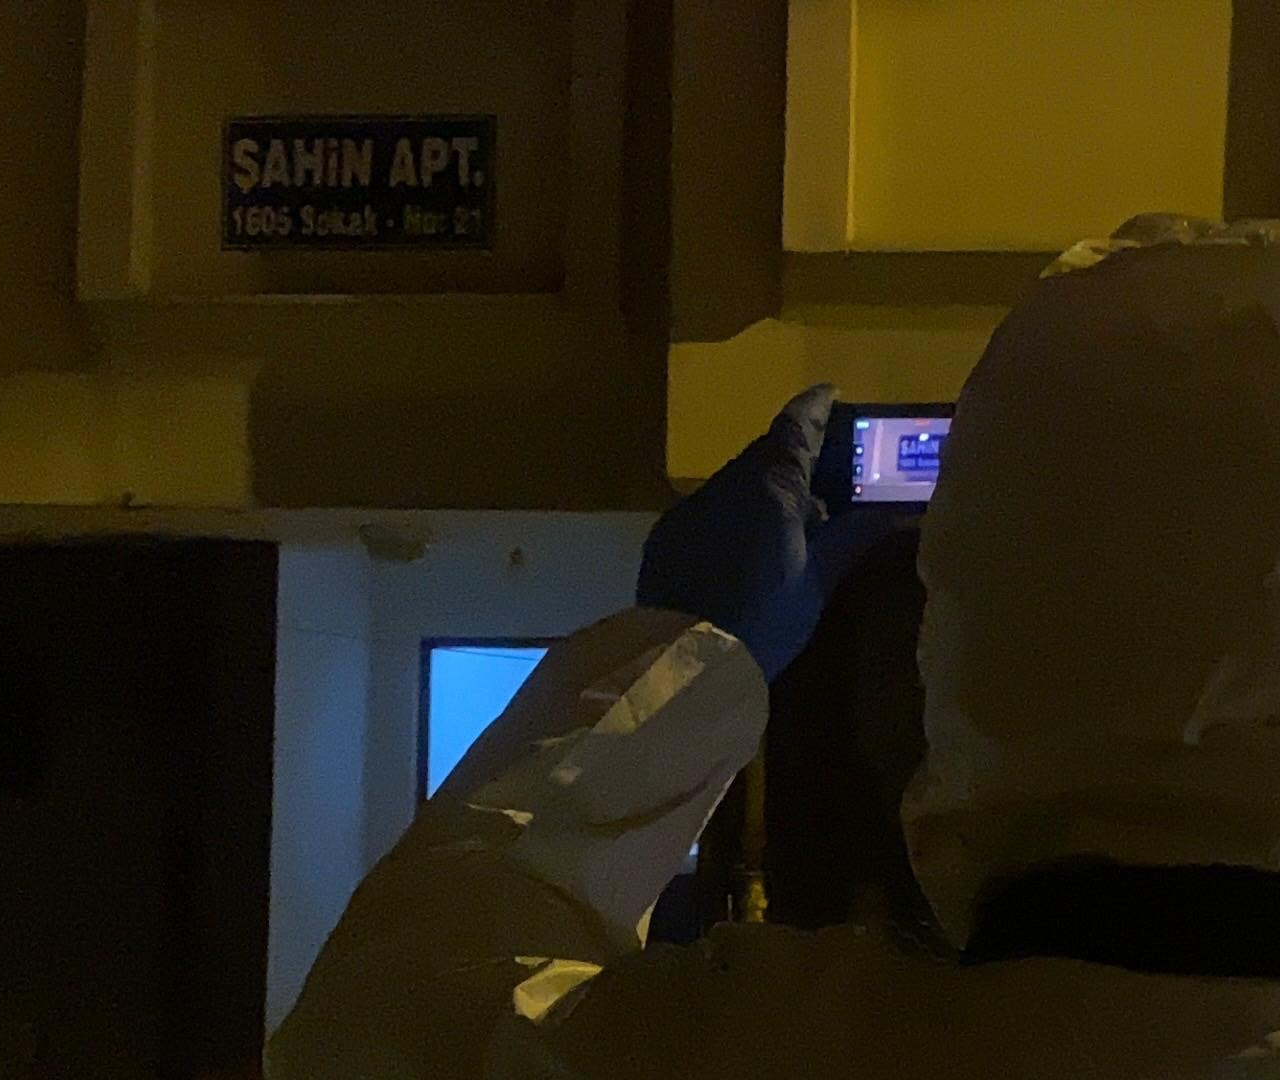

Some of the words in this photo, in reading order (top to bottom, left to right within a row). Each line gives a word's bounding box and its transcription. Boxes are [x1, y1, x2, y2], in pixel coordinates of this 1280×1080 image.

[388, 136, 486, 188] APT.
[232, 204, 292, 236] 1605
[299, 203, 379, 236] Sokak
